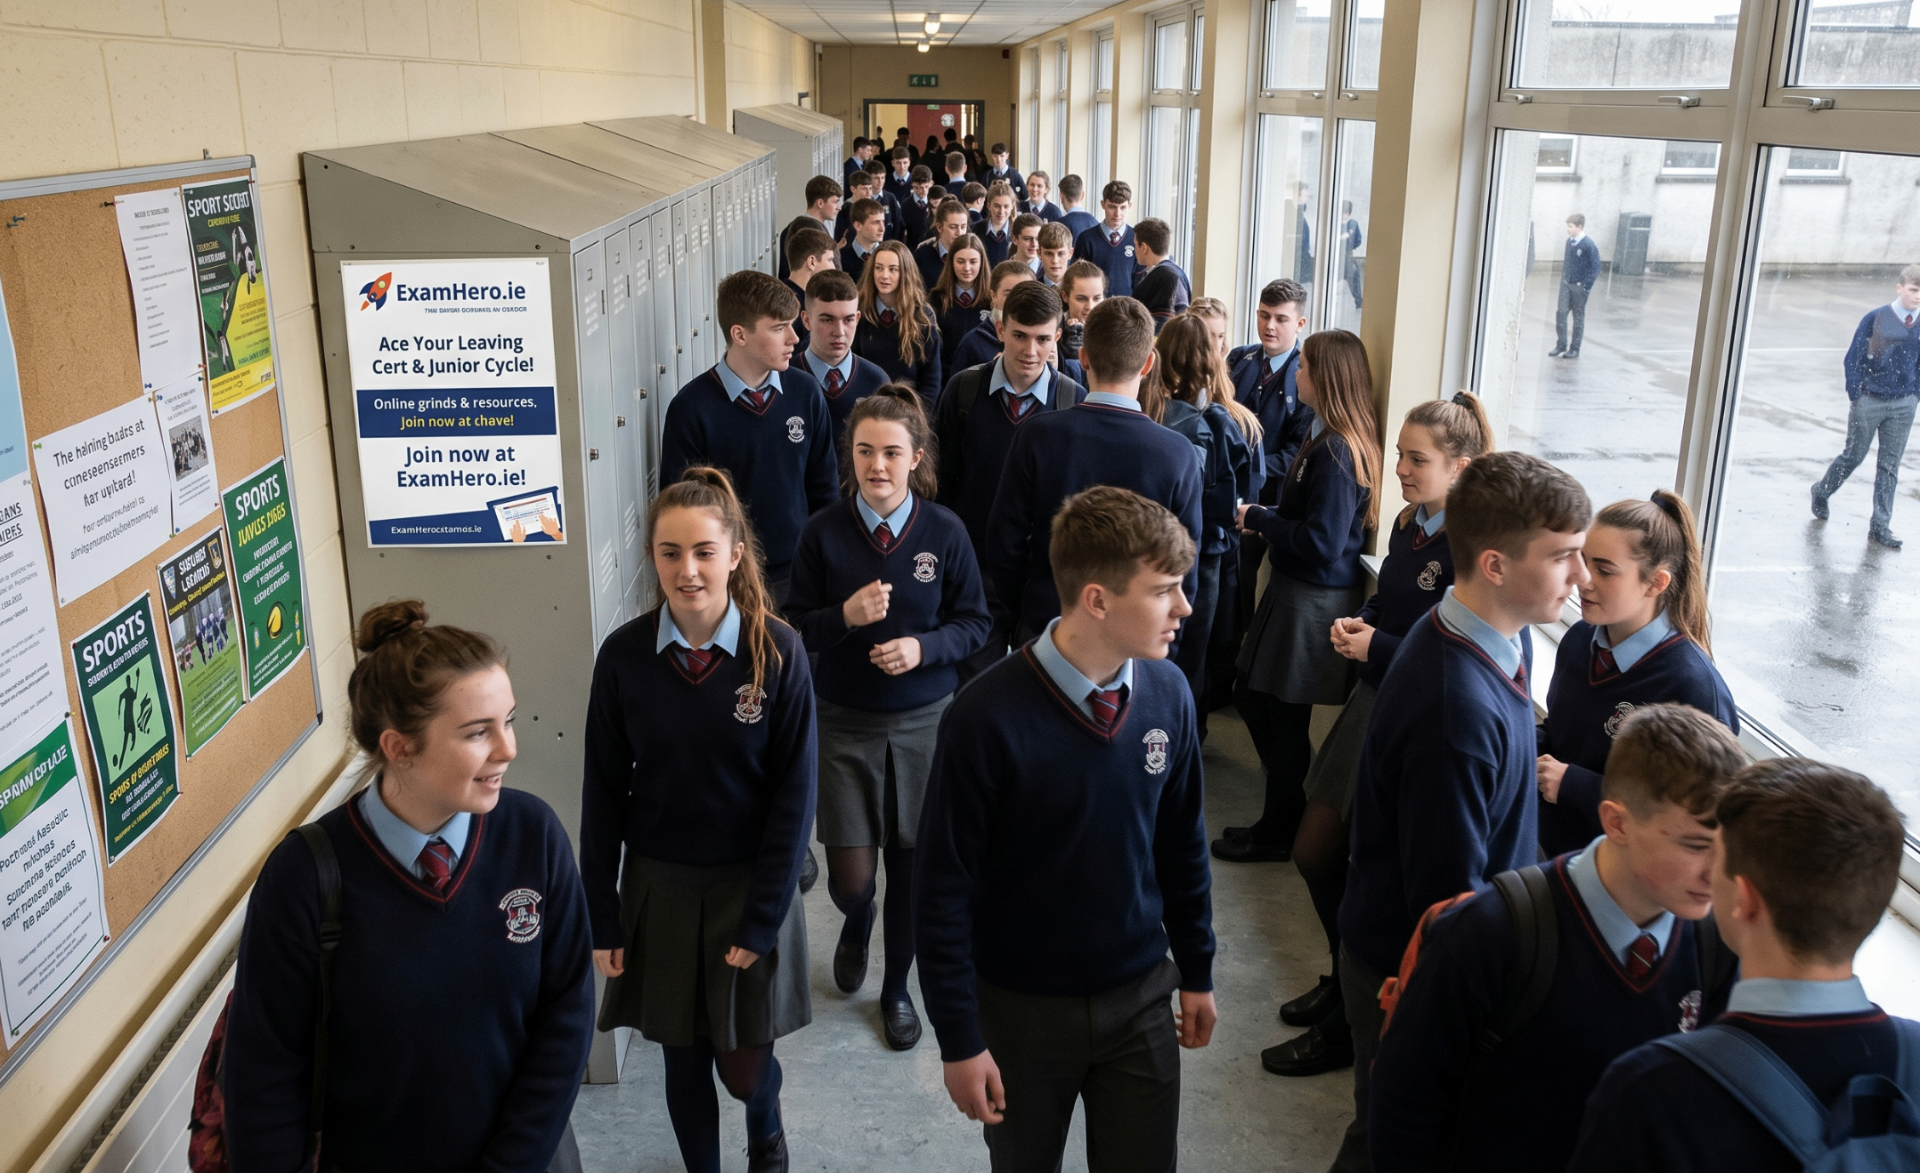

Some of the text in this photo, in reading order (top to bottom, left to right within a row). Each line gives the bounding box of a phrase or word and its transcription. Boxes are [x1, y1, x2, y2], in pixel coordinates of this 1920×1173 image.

[188, 196, 221, 218] SPORT
[396, 281, 526, 302] ExamHero.ie
[379, 334, 524, 354] Ace Your Leaving
[372, 357, 534, 377] Cert & Junior Cycle!
[374, 398, 415, 410] Online
[418, 397, 457, 412] grinds
[460, 397, 470, 409] &
[401, 415, 514, 430] Join now at chave!
[54, 451, 74, 467] The
[135, 418, 145, 433] at
[404, 446, 515, 467] Join now at
[397, 470, 526, 488] ExamHero.ie!
[236, 474, 280, 520] SPORTS
[83, 610, 145, 673] SPORTS
